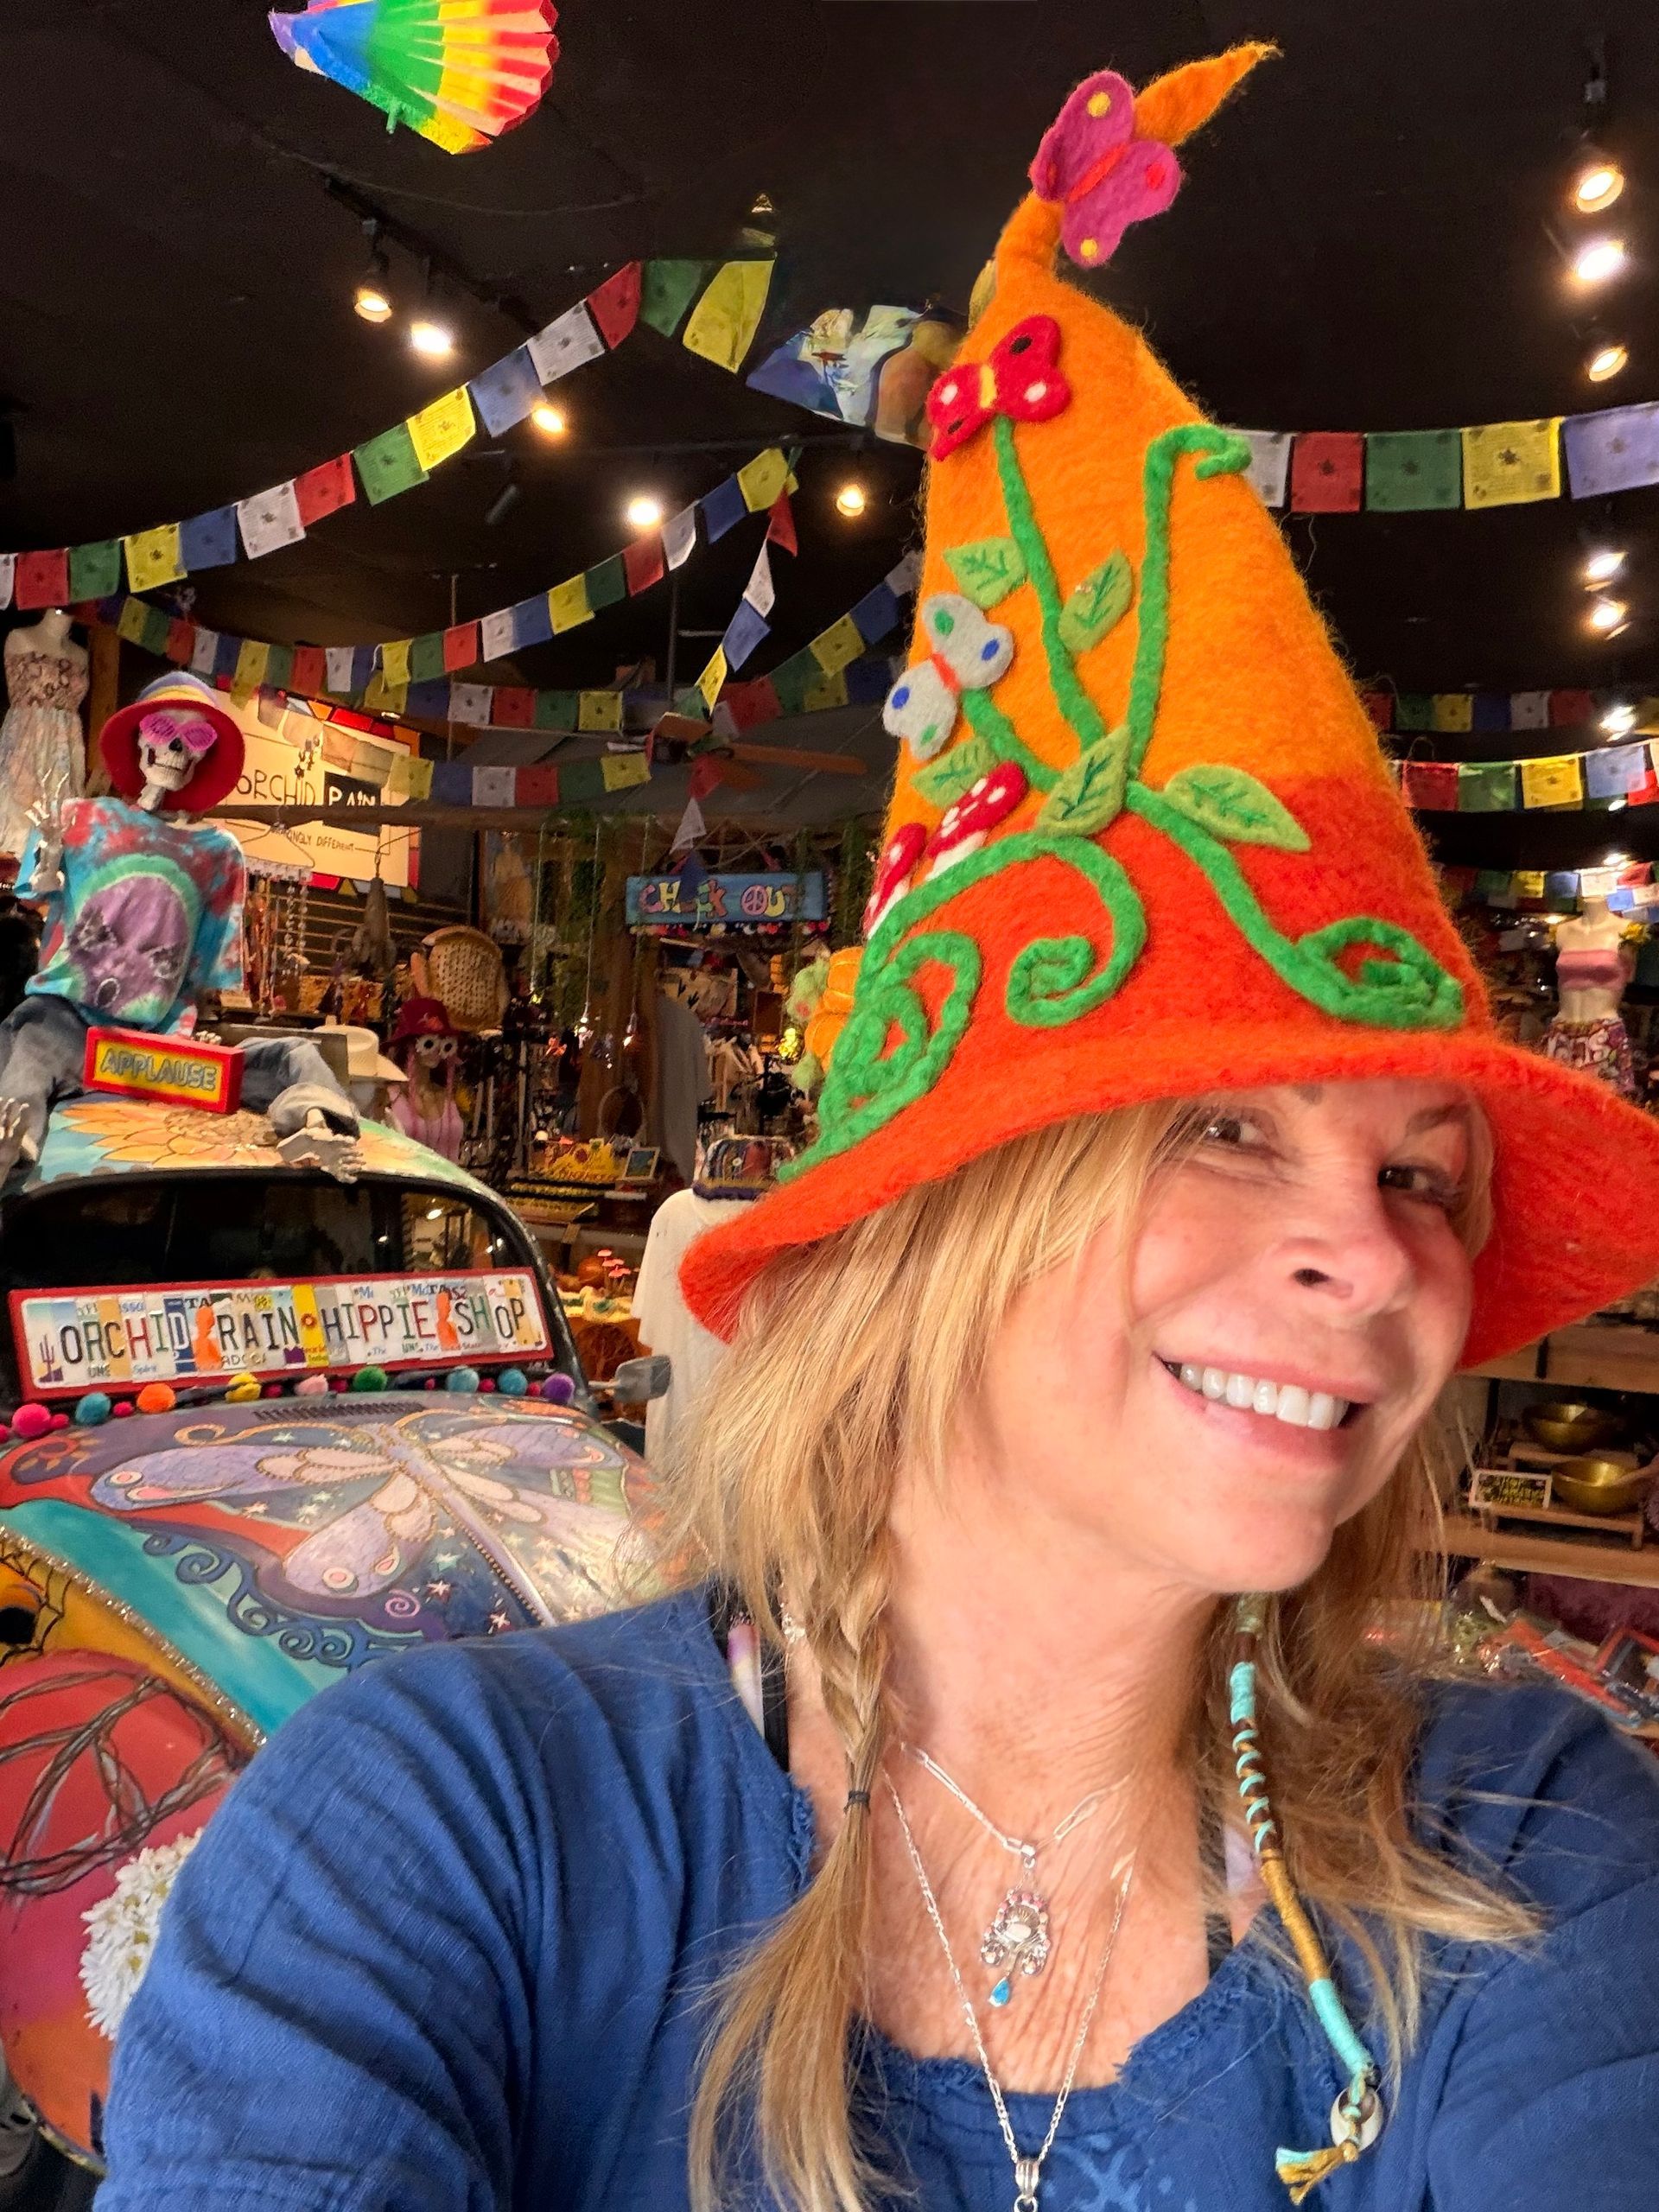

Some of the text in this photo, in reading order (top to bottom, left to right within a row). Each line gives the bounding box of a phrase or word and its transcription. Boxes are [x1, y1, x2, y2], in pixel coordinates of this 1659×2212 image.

[236, 769, 316, 806] ORCHID
[316, 836, 354, 851] DIFFERENT
[100, 1047, 218, 1091] APPLAUSE
[60, 1294, 524, 1364] ORCHID RAIN HIPPIE SHOP
